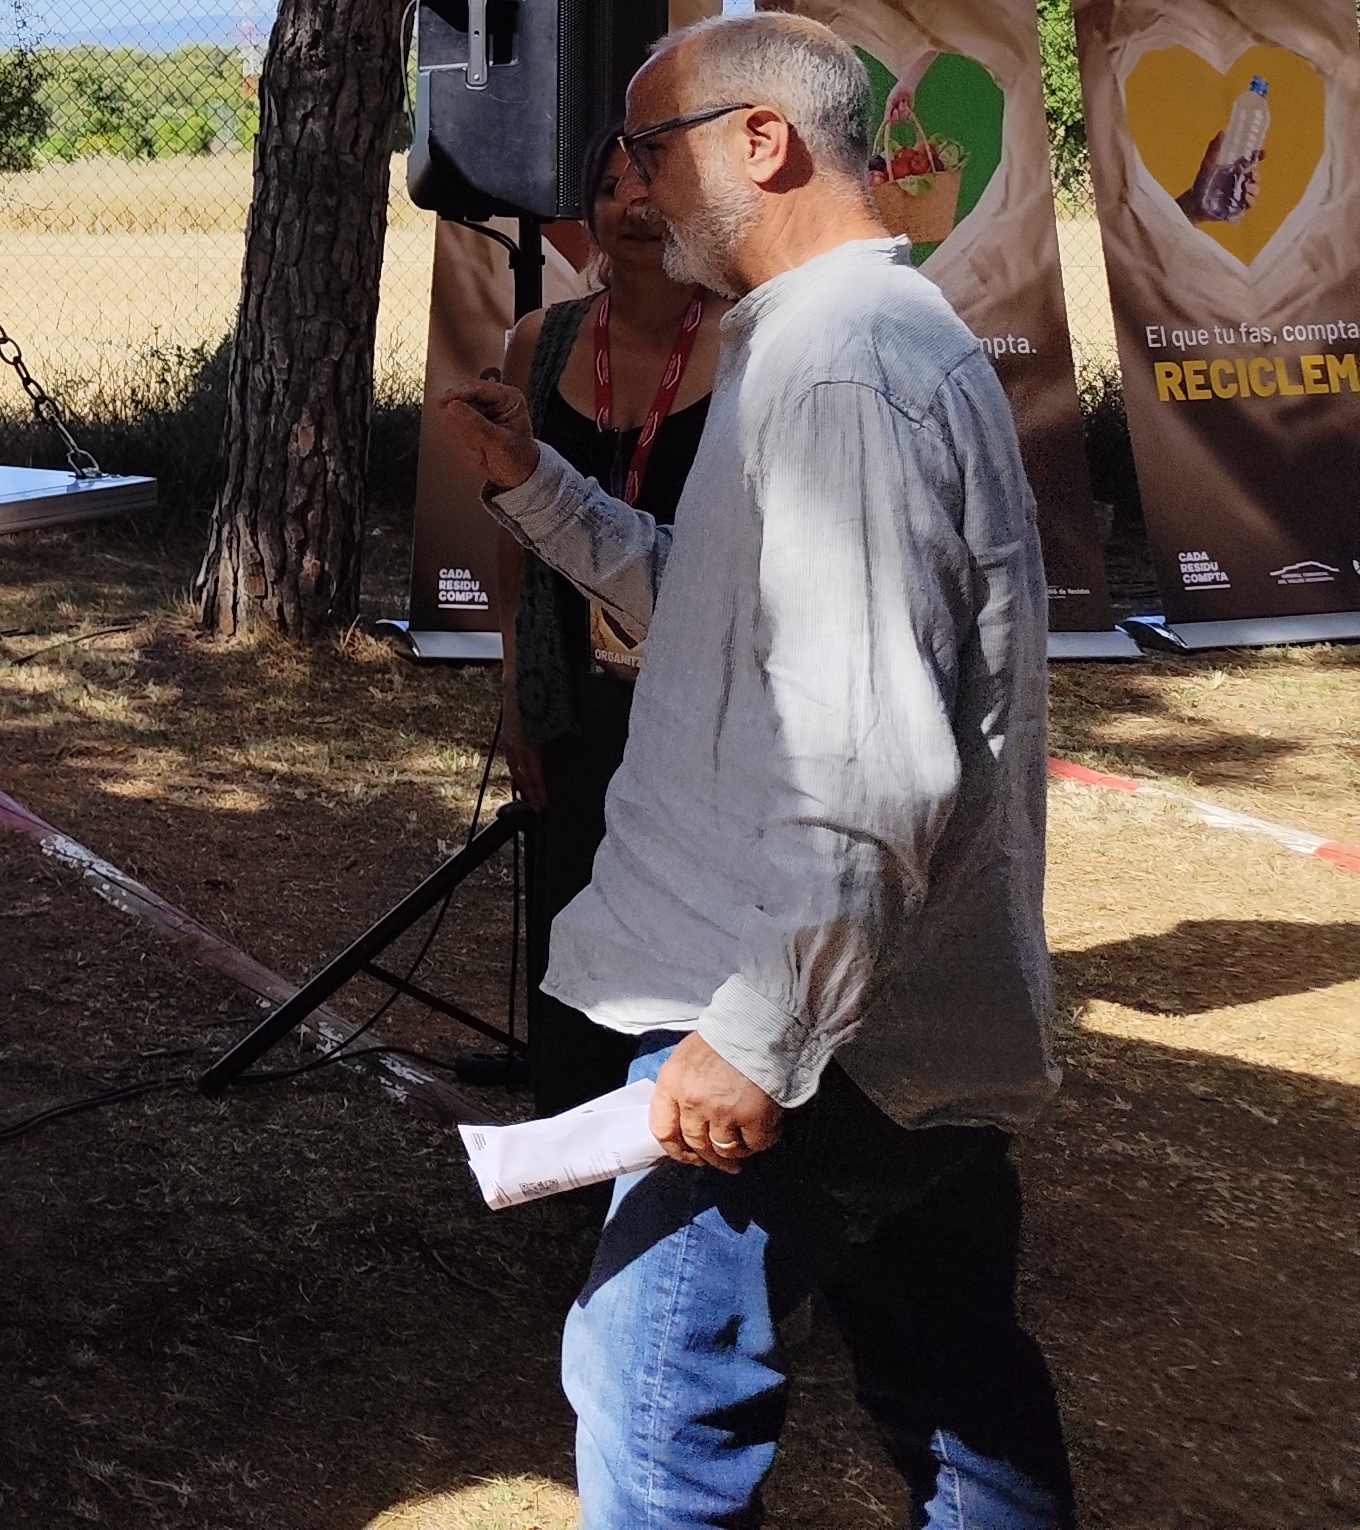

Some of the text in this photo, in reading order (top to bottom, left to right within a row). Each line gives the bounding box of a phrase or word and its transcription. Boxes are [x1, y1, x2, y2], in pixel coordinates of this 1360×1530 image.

[1145, 326, 1167, 348] El
[1171, 328, 1210, 351] que
[1214, 325, 1236, 344] tu
[1239, 322, 1278, 344] fas,
[1154, 354, 1360, 401] RECICLEM
[1178, 551, 1210, 562] CADA
[1180, 561, 1219, 573] RESIDU
[438, 568, 472, 579] CADA
[1182, 572, 1230, 584] COMPTA
[438, 579, 480, 591] RESIDU
[438, 591, 489, 603] COMPTA
